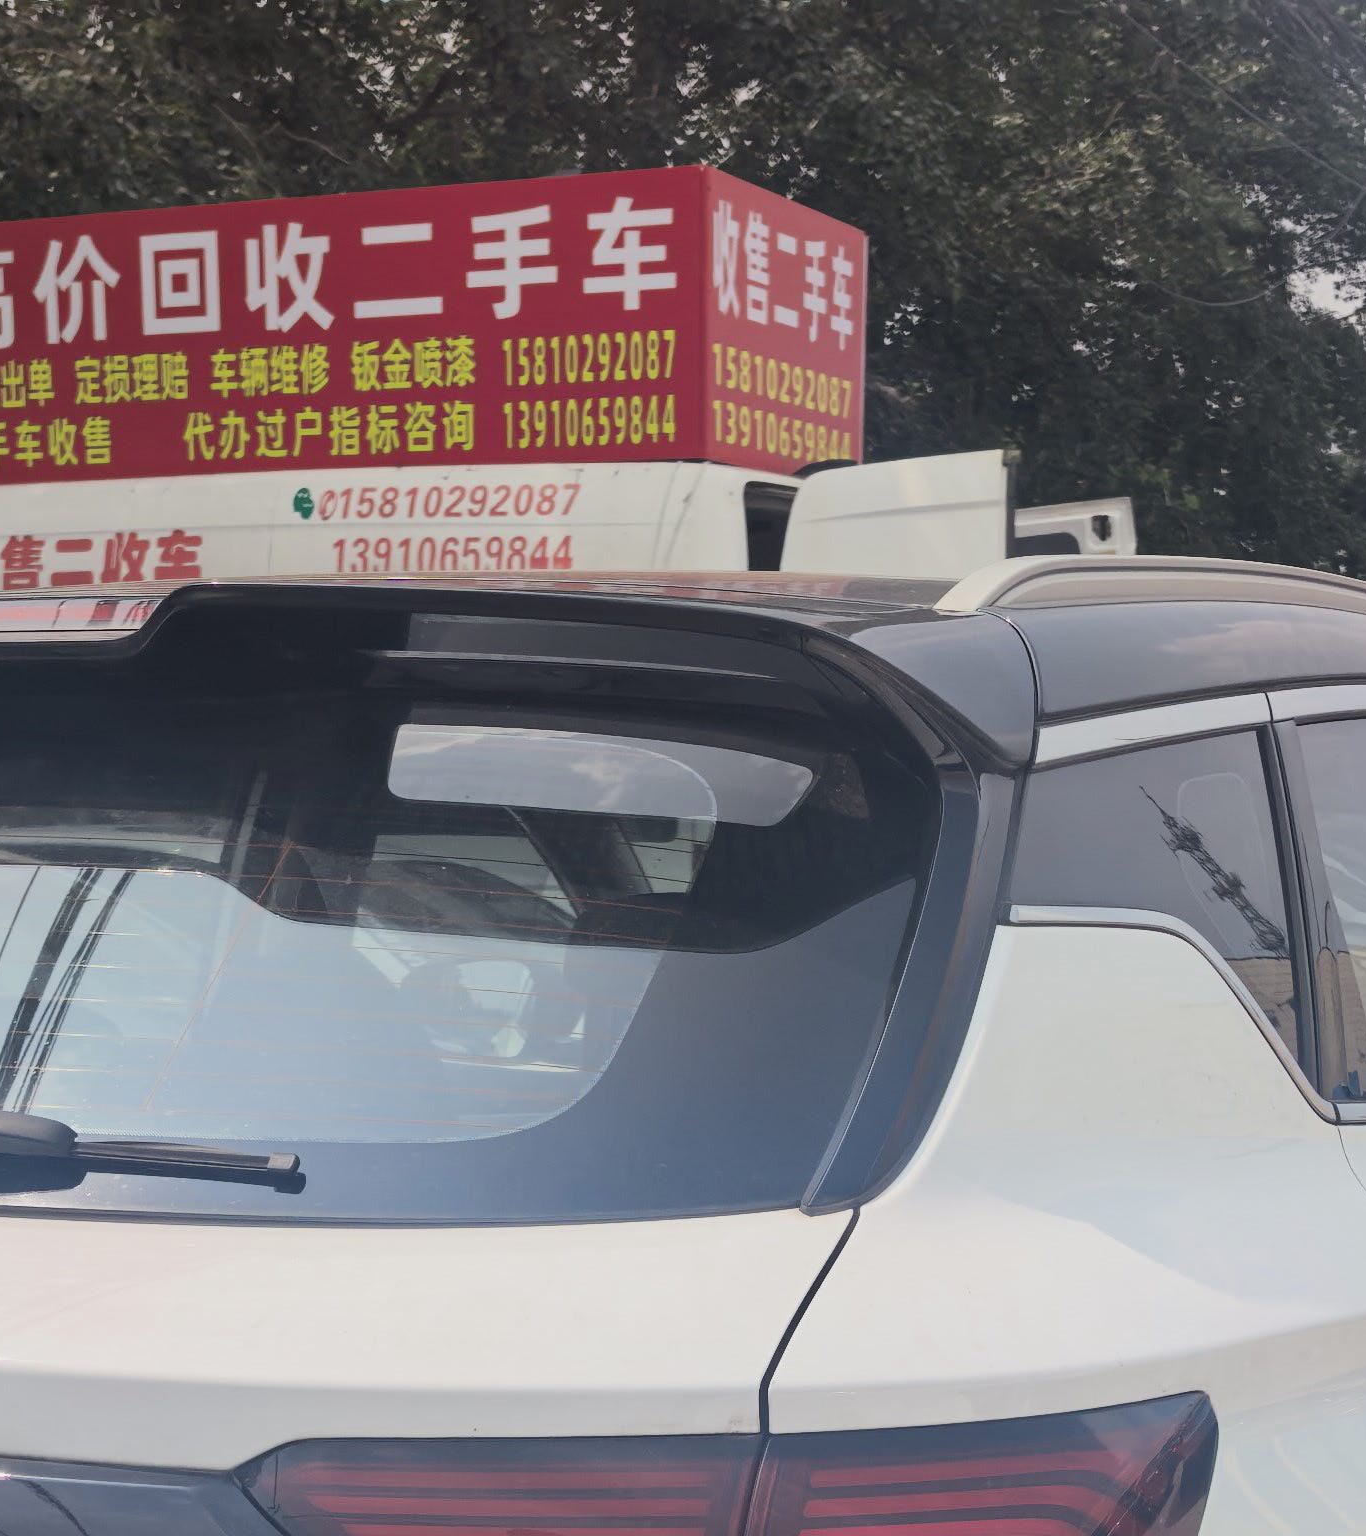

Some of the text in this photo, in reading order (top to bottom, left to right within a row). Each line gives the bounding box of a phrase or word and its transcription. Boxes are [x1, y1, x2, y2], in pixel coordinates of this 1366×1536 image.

[713, 199, 854, 350] 收售二手车
[75, 352, 189, 404] 定损理赔
[210, 343, 329, 398] 车辆维修
[351, 336, 476, 391] 钣金喷漆
[502, 329, 677, 386] 15810292087
[713, 342, 852, 420] 15810292087
[184, 400, 475, 461] 代办过户指标咨询
[502, 394, 677, 449] 13910659844
[337, 484, 581, 519] 15810292087
